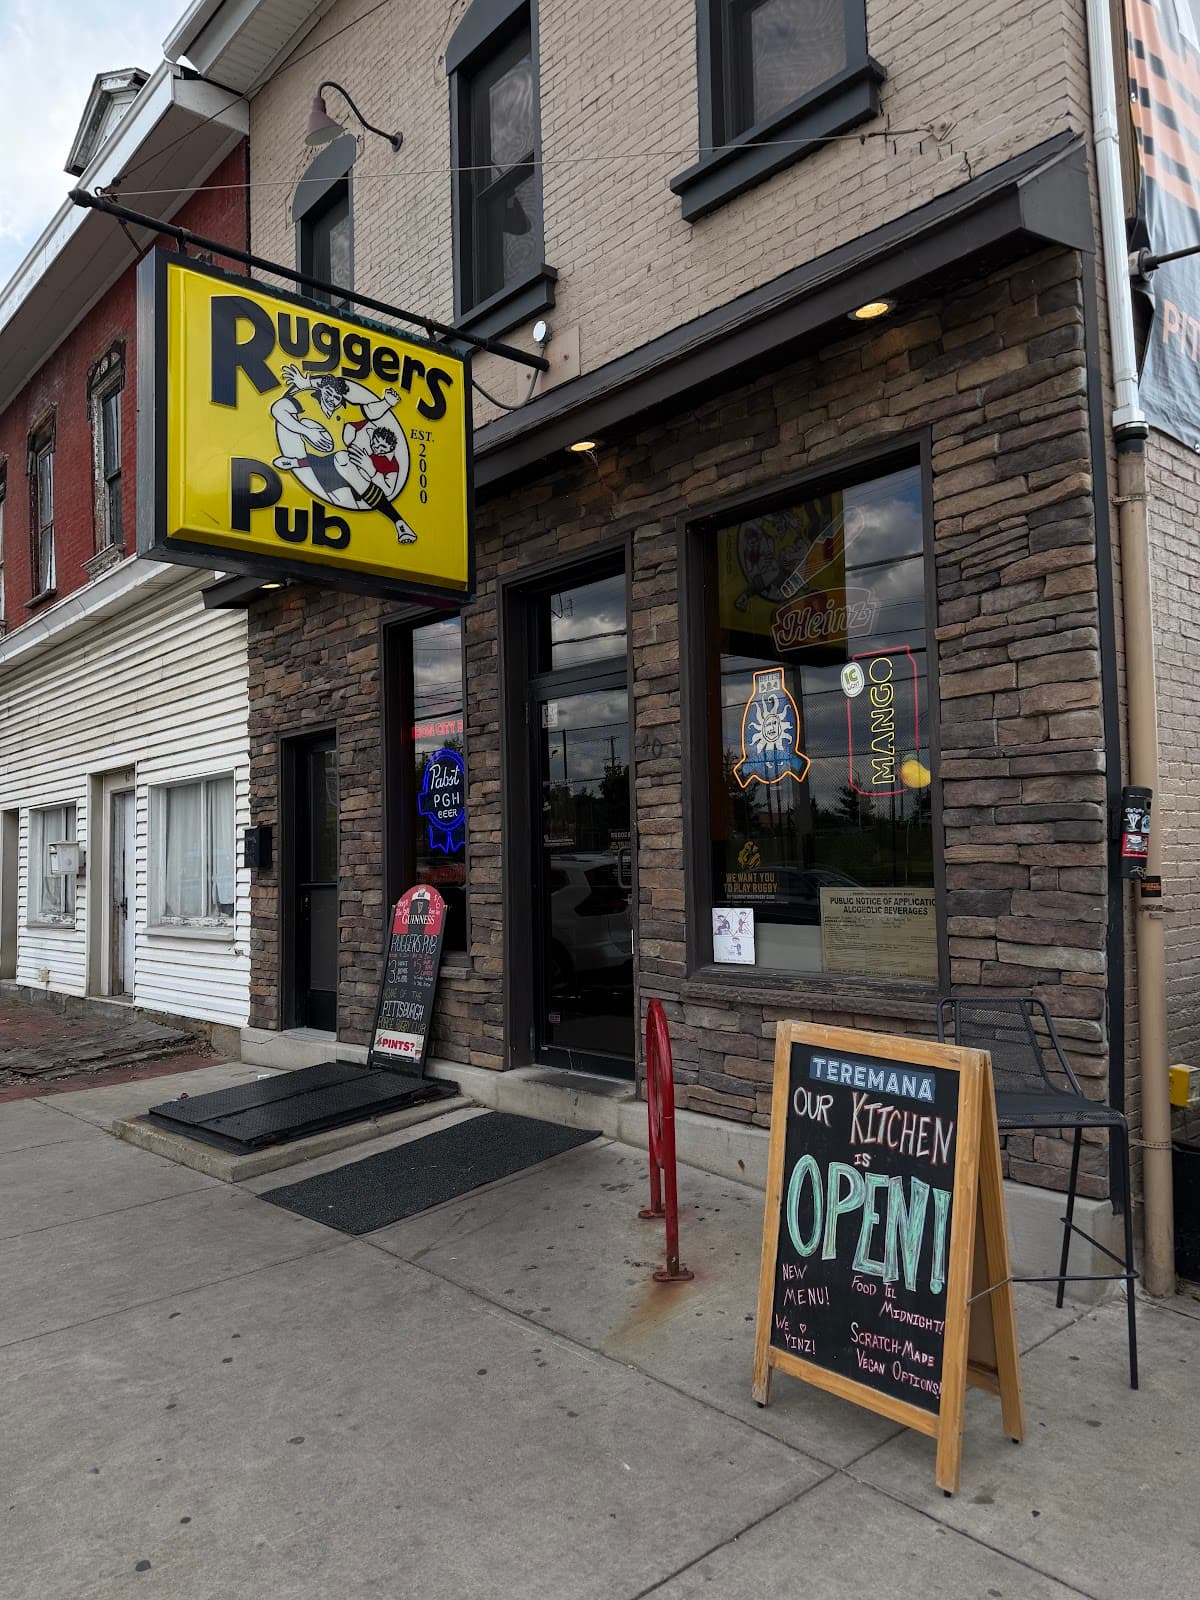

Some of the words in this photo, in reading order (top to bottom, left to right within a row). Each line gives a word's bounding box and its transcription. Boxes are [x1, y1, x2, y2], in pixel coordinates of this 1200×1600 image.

[209, 294, 454, 420] Ruggers
[410, 428, 435, 443] EST.
[418, 444, 428, 504] 2000
[230, 456, 351, 550] Pub
[777, 599, 872, 646] Heinz
[869, 657, 896, 785] MANGO
[429, 763, 461, 790] Pabst
[433, 791, 460, 808] PGH
[437, 808, 458, 819] BEER
[726, 872, 737, 883] WE
[738, 872, 757, 883] WANT
[759, 872, 775, 883] YOU
[734, 883, 750, 893] PLAY
[752, 883, 777, 893] RUGBY
[830, 897, 854, 905] PUBLIC
[856, 897, 881, 906] NOTICE
[884, 898, 892, 906] OF
[843, 905, 883, 914] ALCOHOLIC
[884, 906, 928, 916] BEVERAGES
[402, 914, 435, 925] GUINNESS
[812, 1056, 934, 1101] TEREMANA
[792, 1086, 834, 1128] OUR
[849, 1091, 954, 1166] KITCHEN
[853, 1152, 872, 1168] IS
[786, 1153, 952, 1296] OPEN!
[782, 1263, 808, 1281] NEW
[783, 1286, 831, 1307] MENU!
[784, 1333, 816, 1355] YINZ!
